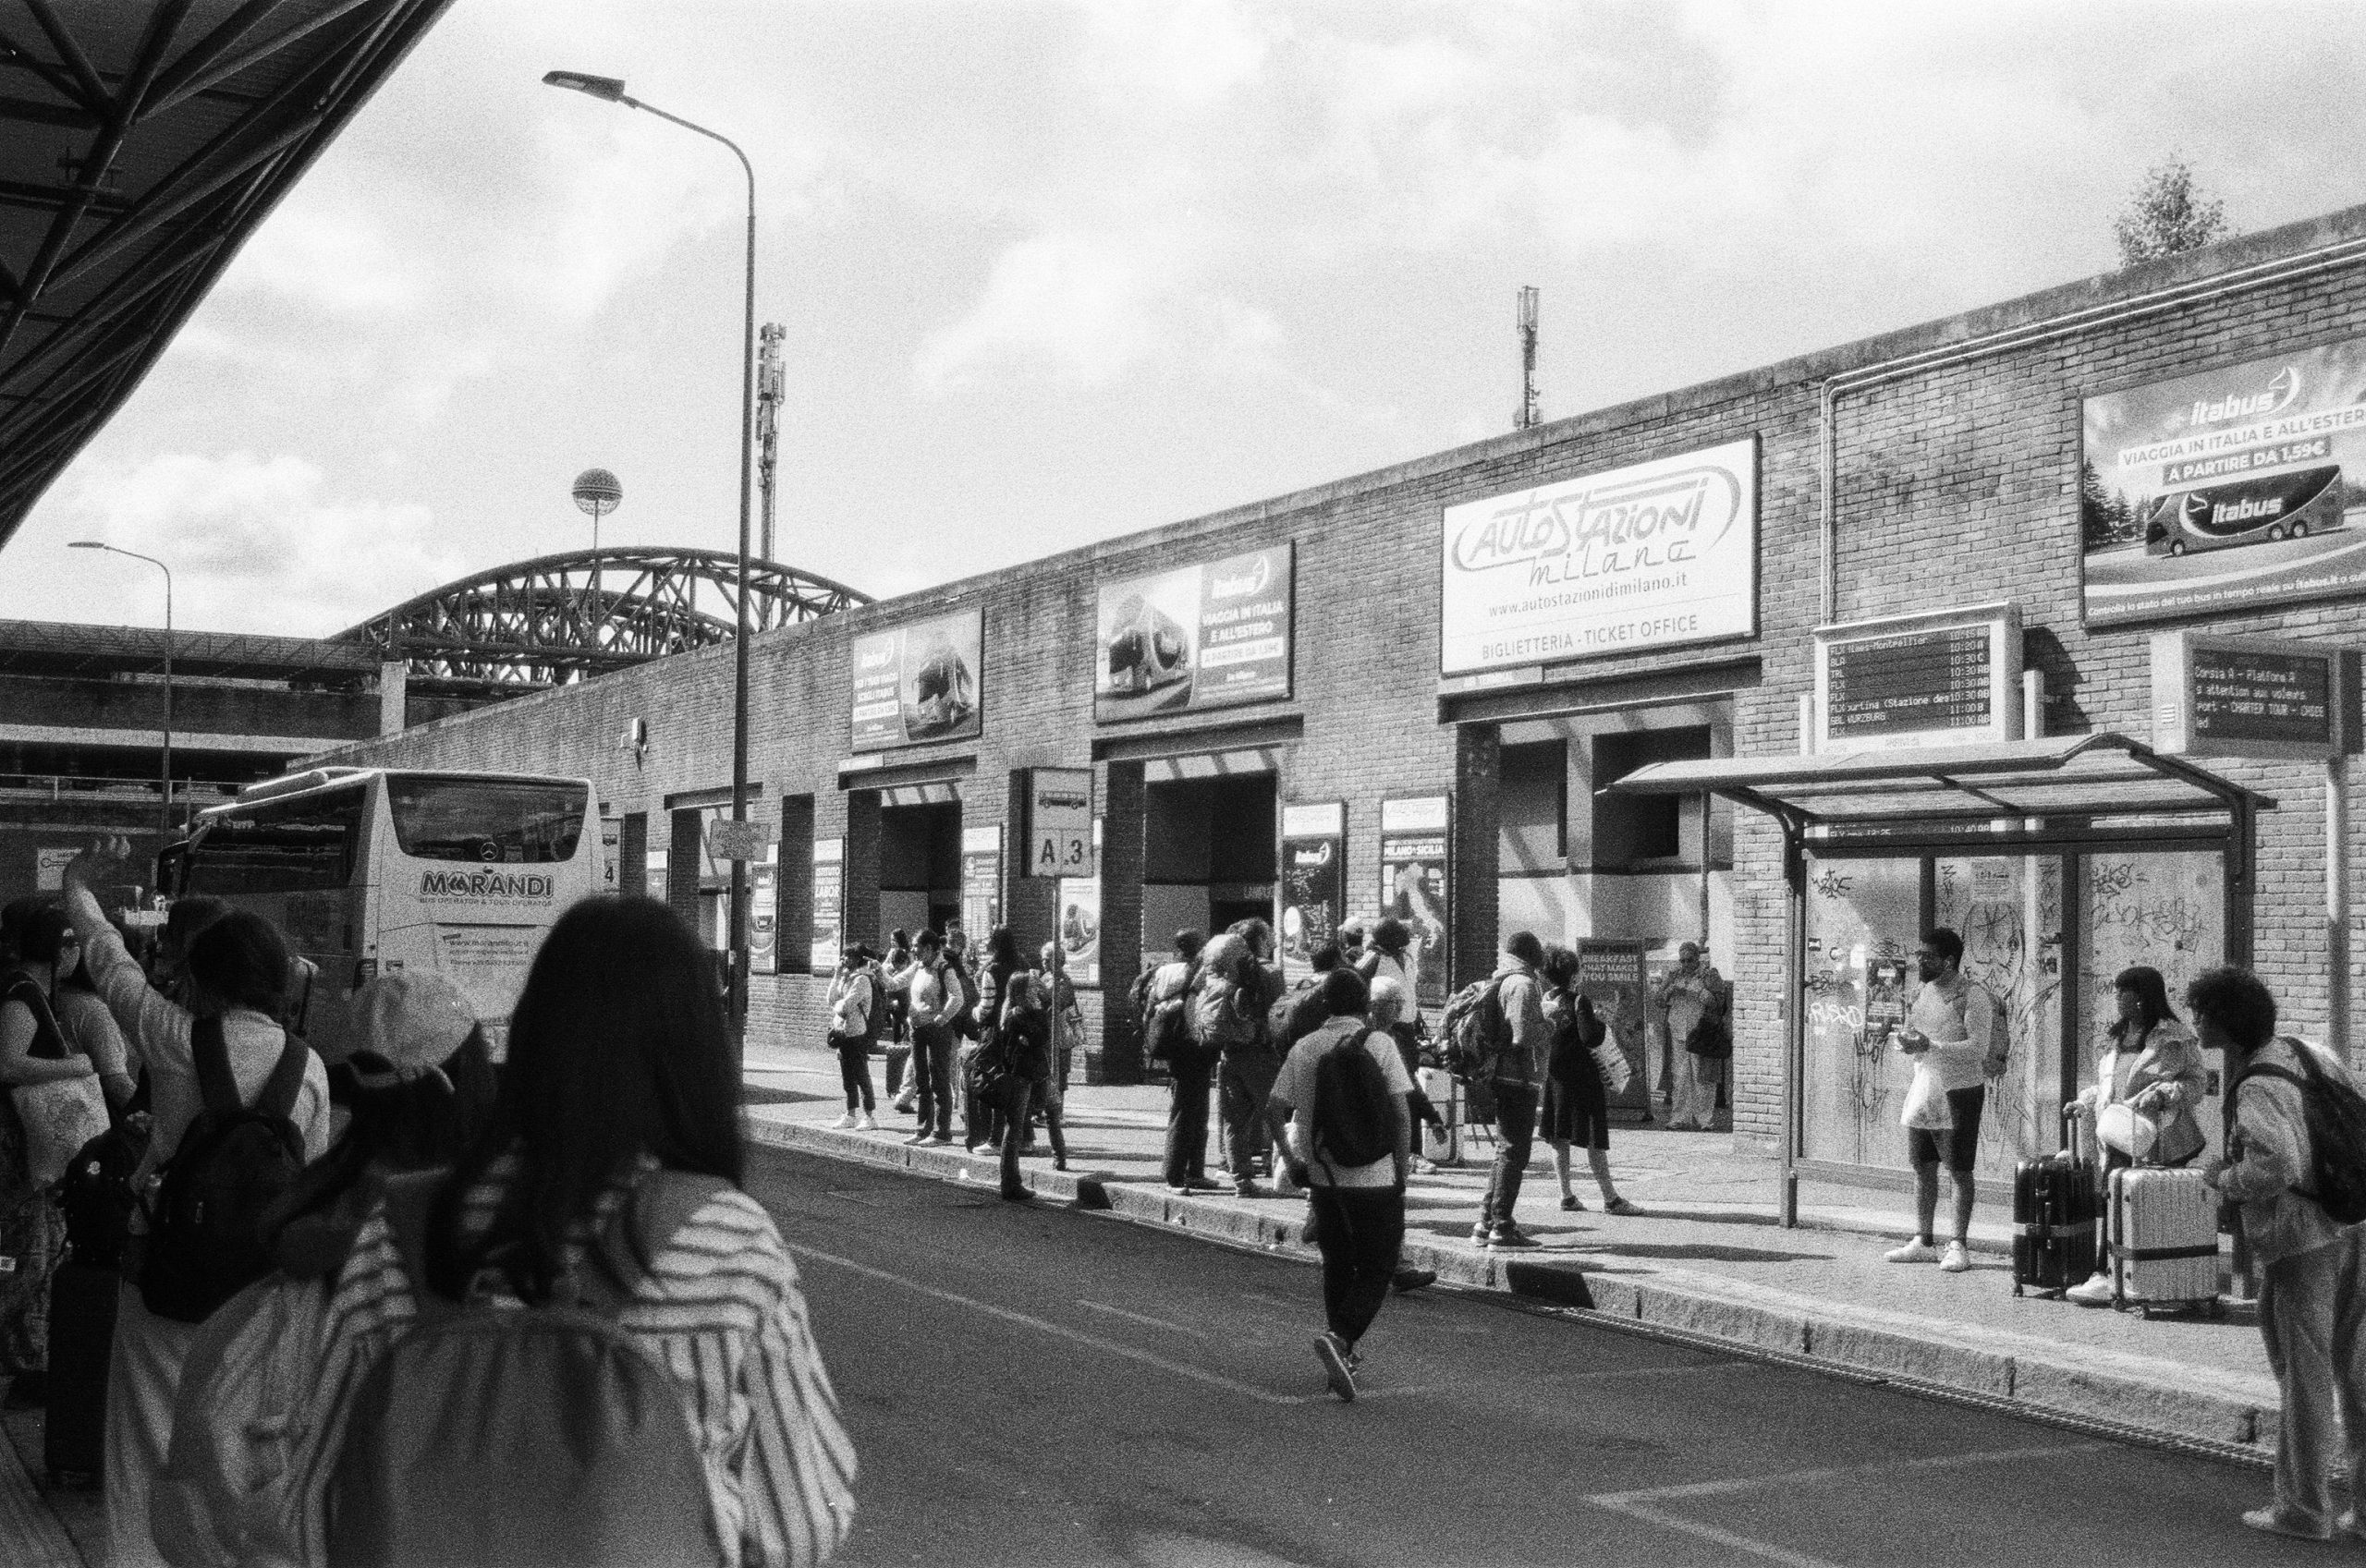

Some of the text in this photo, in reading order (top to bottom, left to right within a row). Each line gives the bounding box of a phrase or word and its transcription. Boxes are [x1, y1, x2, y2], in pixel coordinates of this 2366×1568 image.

[2190, 391, 2275, 426] itabus
[2123, 408, 2365, 467] VIAGGIA IN ITALIA E ALL'ESTER
[2168, 441, 2325, 482] A PARTIRE DA 1,59€
[2212, 497, 2282, 524] itabus
[1488, 572, 1688, 617] www.autostazionidimilano.it
[2194, 593, 2211, 603] bus
[1482, 632, 1573, 660] BIGLIETTERIA
[1585, 625, 1635, 645] TICKET
[1640, 614, 1699, 638] OFFICE
[1950, 641, 1976, 652] 10:20
[1950, 653, 1976, 665] 10:30
[1977, 652, 1984, 662] C
[1830, 681, 1846, 690] FLX
[1950, 666, 1976, 677] 10:30
[1830, 693, 1846, 701] FLX
[1950, 678, 1976, 690] 10:30
[1830, 704, 1846, 712] FLX
[1950, 690, 1976, 701] 10:30
[1950, 703, 1976, 714] 11:00
[1950, 715, 1976, 726] 11:00
[1041, 838, 1055, 864] A
[604, 867, 615, 882] 4
